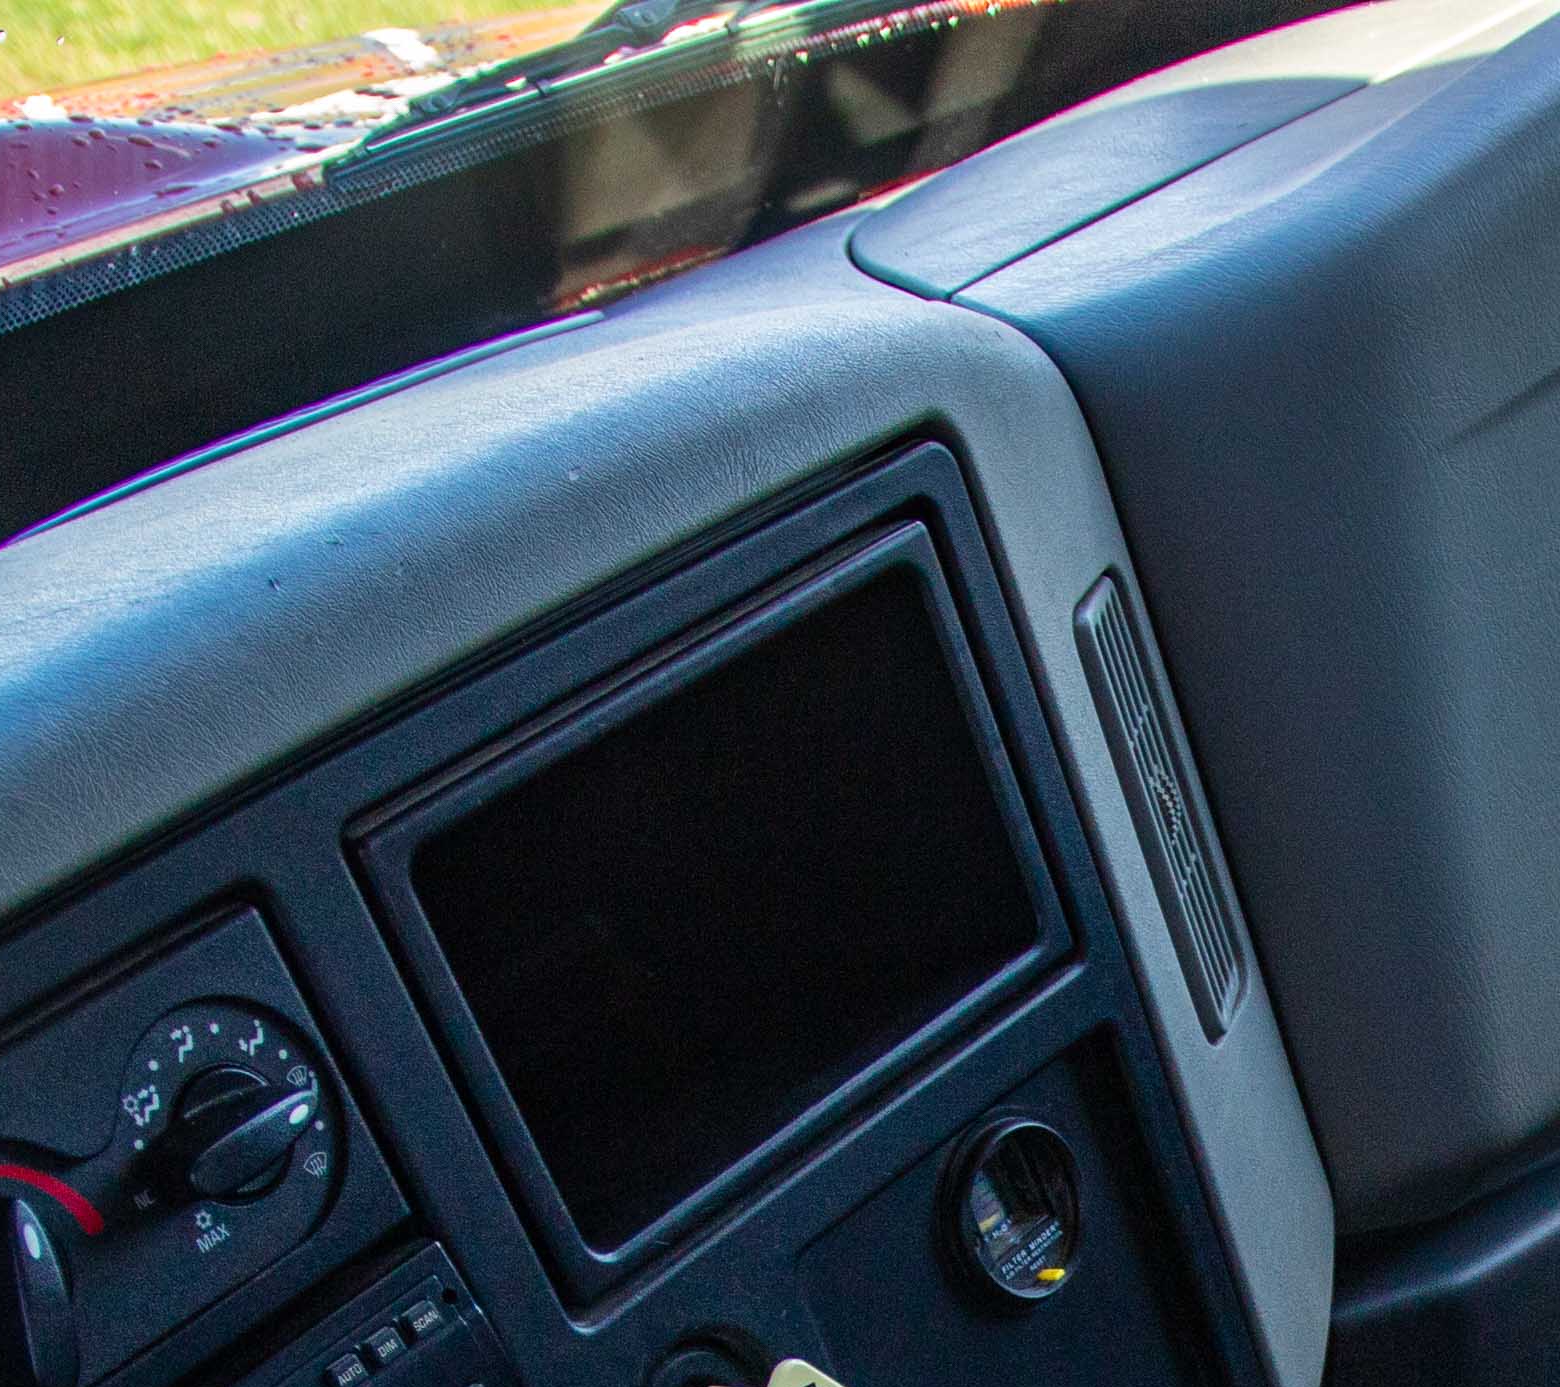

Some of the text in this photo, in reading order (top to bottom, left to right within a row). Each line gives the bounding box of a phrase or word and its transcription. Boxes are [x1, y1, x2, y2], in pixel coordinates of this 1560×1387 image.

[196, 1224, 230, 1253] MAX
[412, 1309, 439, 1333] SCAN
[377, 1338, 399, 1358] DIM
[338, 1364, 362, 1387] AUTO
